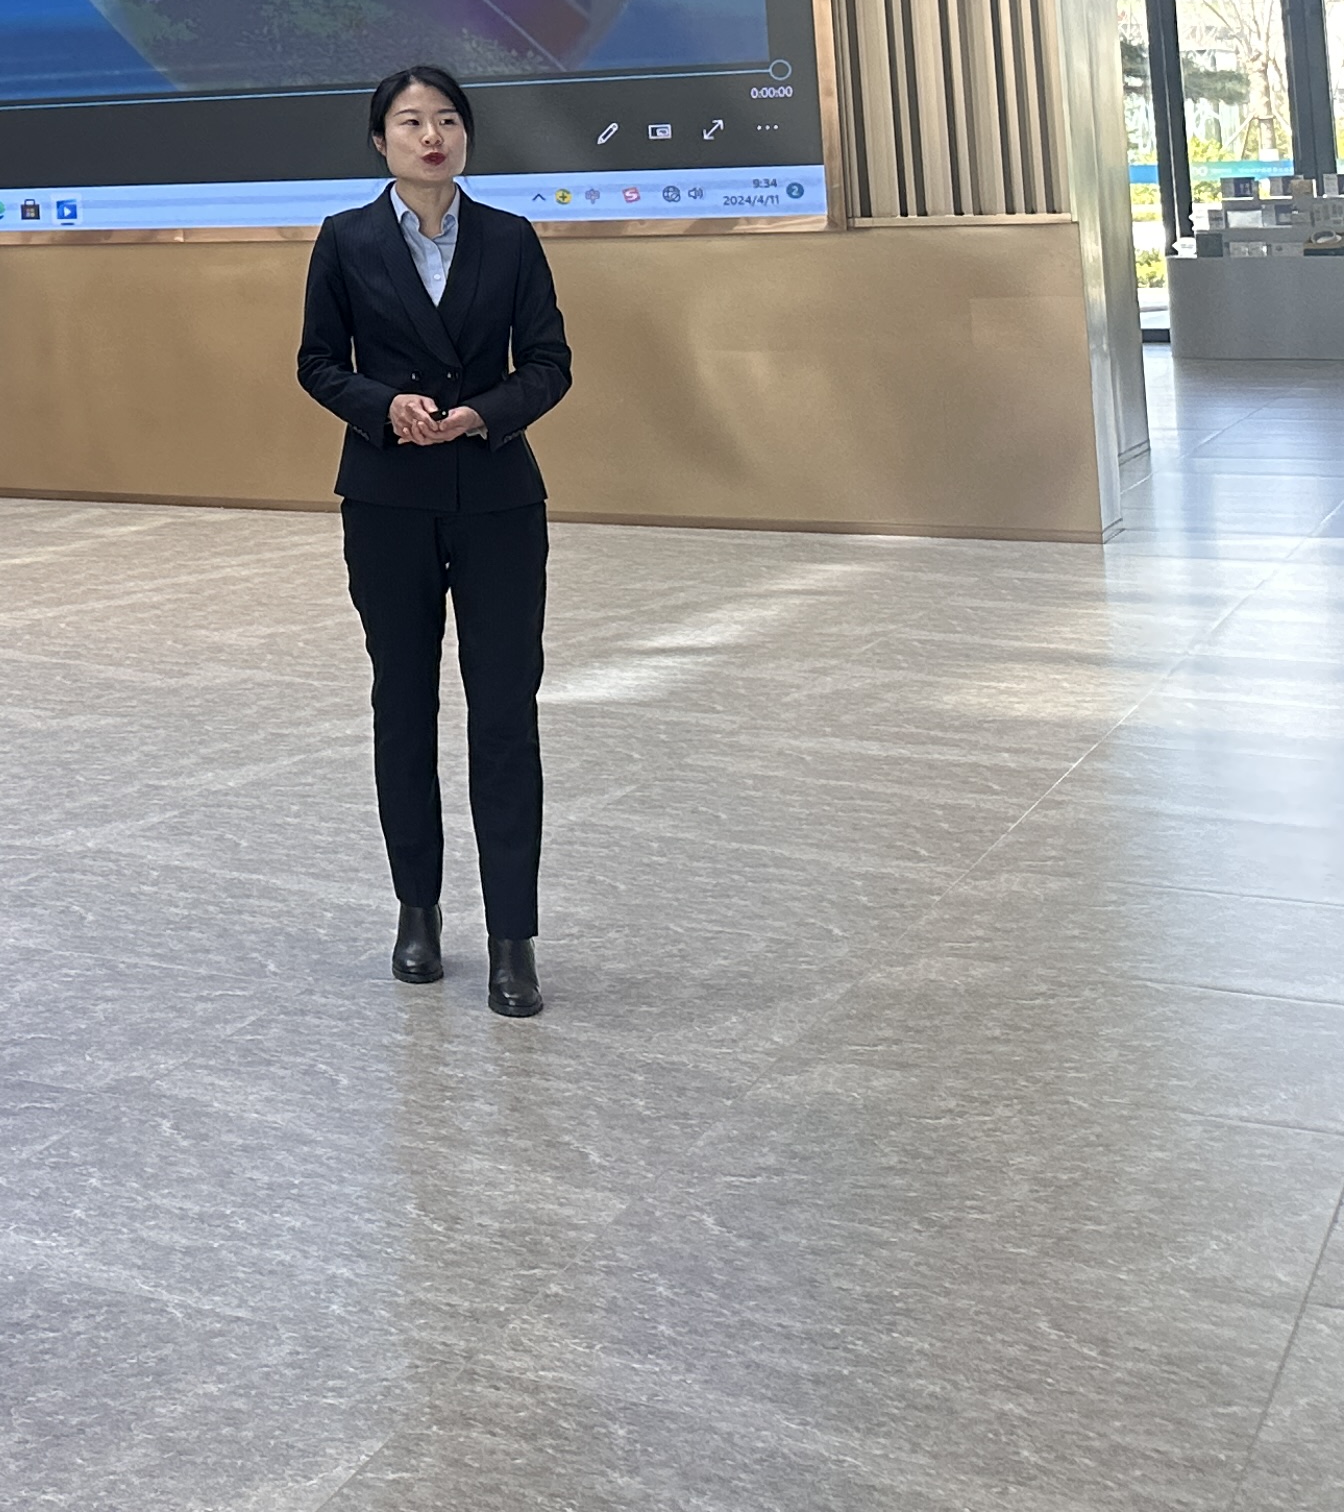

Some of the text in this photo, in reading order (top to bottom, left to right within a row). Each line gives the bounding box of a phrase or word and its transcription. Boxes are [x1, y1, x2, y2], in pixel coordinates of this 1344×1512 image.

[750, 86, 793, 99] 0:00:00
[752, 178, 778, 189] 9:34
[723, 194, 780, 206] 2024/4/11
